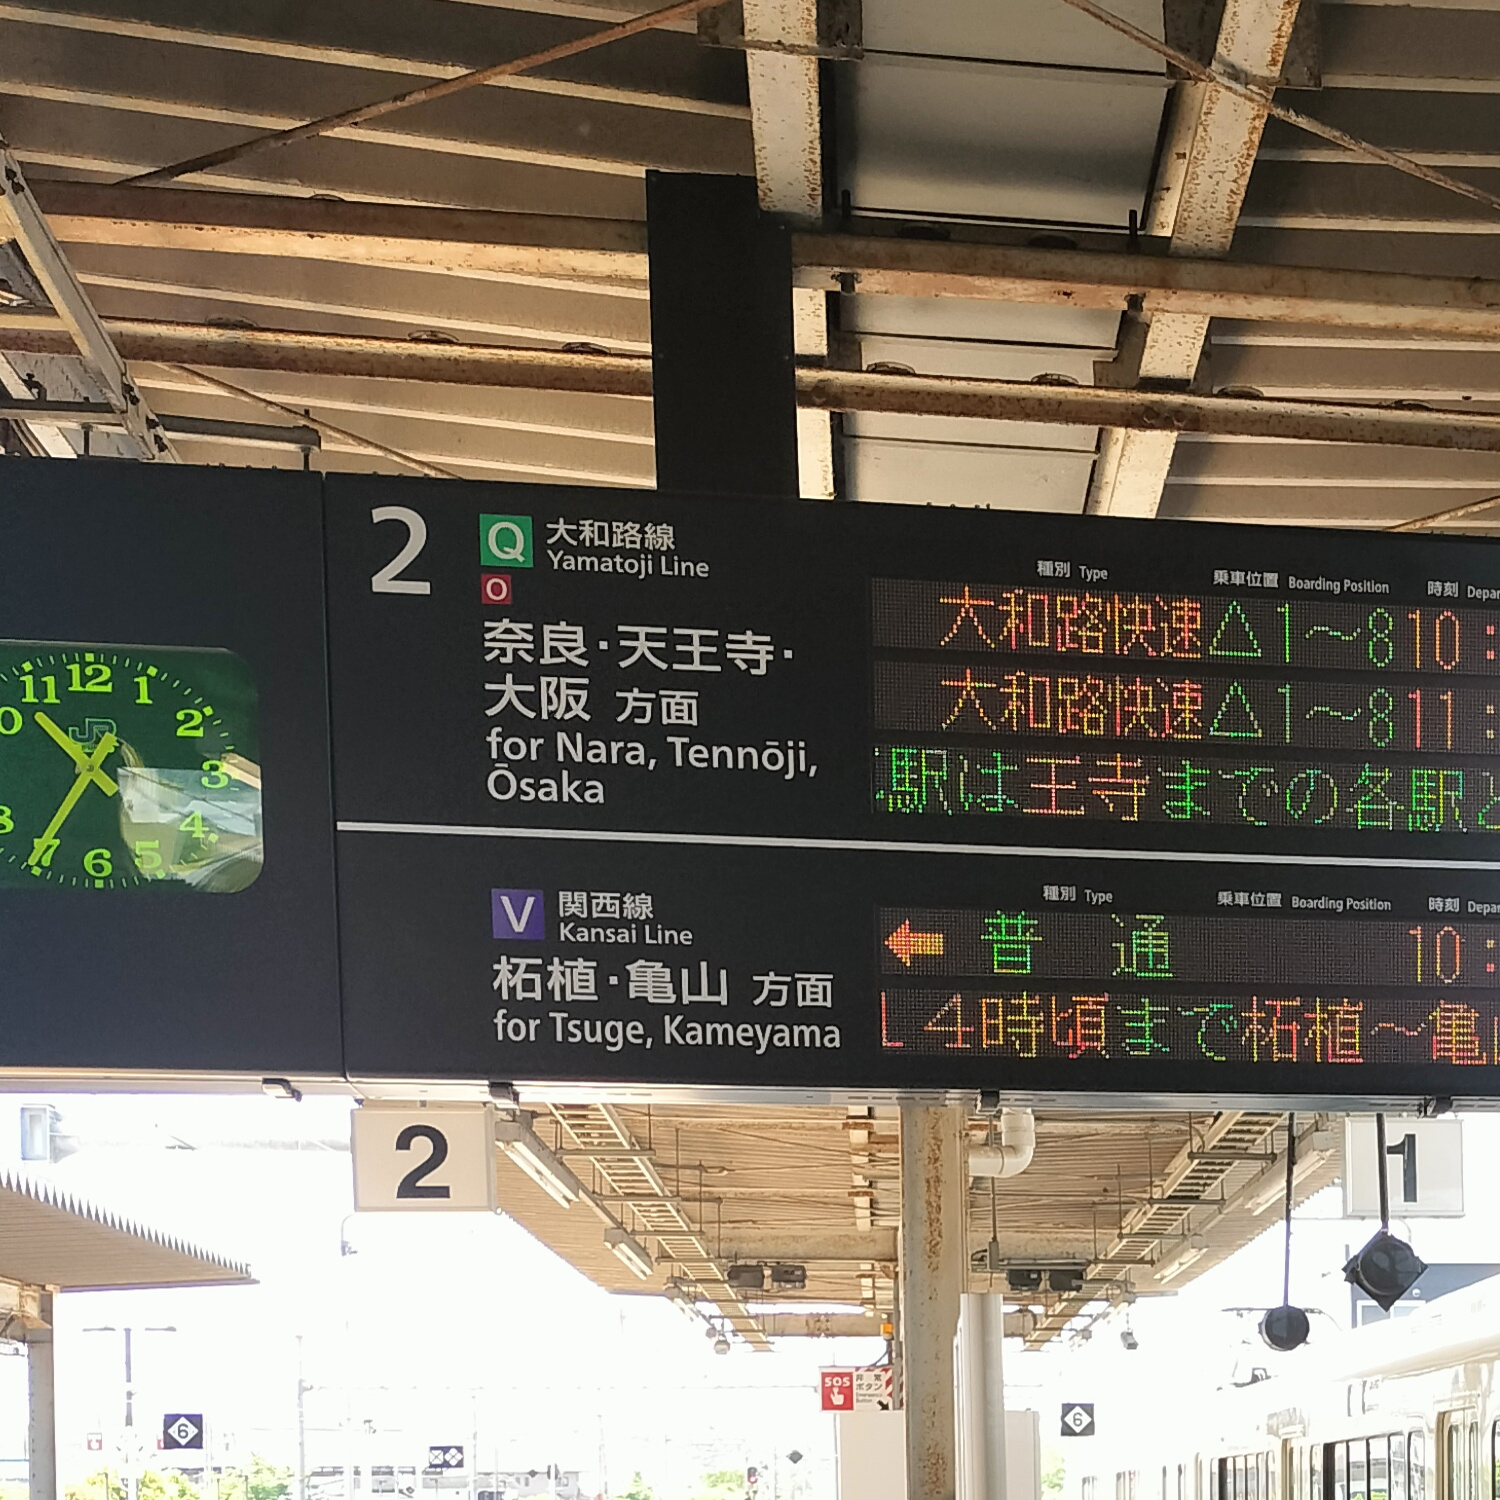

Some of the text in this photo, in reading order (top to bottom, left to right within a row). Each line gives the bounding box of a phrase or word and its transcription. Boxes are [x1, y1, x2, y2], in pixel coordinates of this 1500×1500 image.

[487, 522, 525, 562] Q
[546, 517, 676, 551] 大和路線
[369, 506, 431, 596] 2
[546, 549, 710, 579] Yamatoji Line
[1037, 560, 1108, 583] 種別 Type
[1213, 569, 1390, 594] 乗車位置 Boarding Position
[1427, 580, 1459, 598] 時刻
[940, 584, 1201, 658] 大和路快速
[20, 675, 61, 704] 11
[66, 664, 113, 692] 12
[134, 676, 153, 704] 1
[484, 673, 699, 726] 大阪 方面
[940, 668, 1202, 740] 大和路快速
[176, 709, 204, 737] 2
[486, 726, 818, 781] for Nara, Tennōji,
[201, 760, 229, 788] 3
[487, 763, 606, 804] Ōsaka
[179, 811, 209, 838] 4
[33, 838, 60, 867] 7
[84, 849, 113, 877] 6
[134, 840, 163, 869] 5
[558, 890, 654, 920] 関西線
[1043, 884, 1114, 906] 種別 Type
[1217, 890, 1392, 913] 乗車位置 Boarding Position
[1427, 896, 1460, 914] 時刻
[500, 896, 536, 933] V
[559, 922, 693, 946] Kansai Line
[493, 955, 834, 1008] 柘植・亀山 方面
[493, 1009, 842, 1055] for Tsuge, Kameyama
[395, 1124, 451, 1200] 2
[1386, 1132, 1418, 1203] 1
[825, 1377, 851, 1387] SOS
[177, 1423, 189, 1439] 6
[1073, 1412, 1083, 1427] 6
